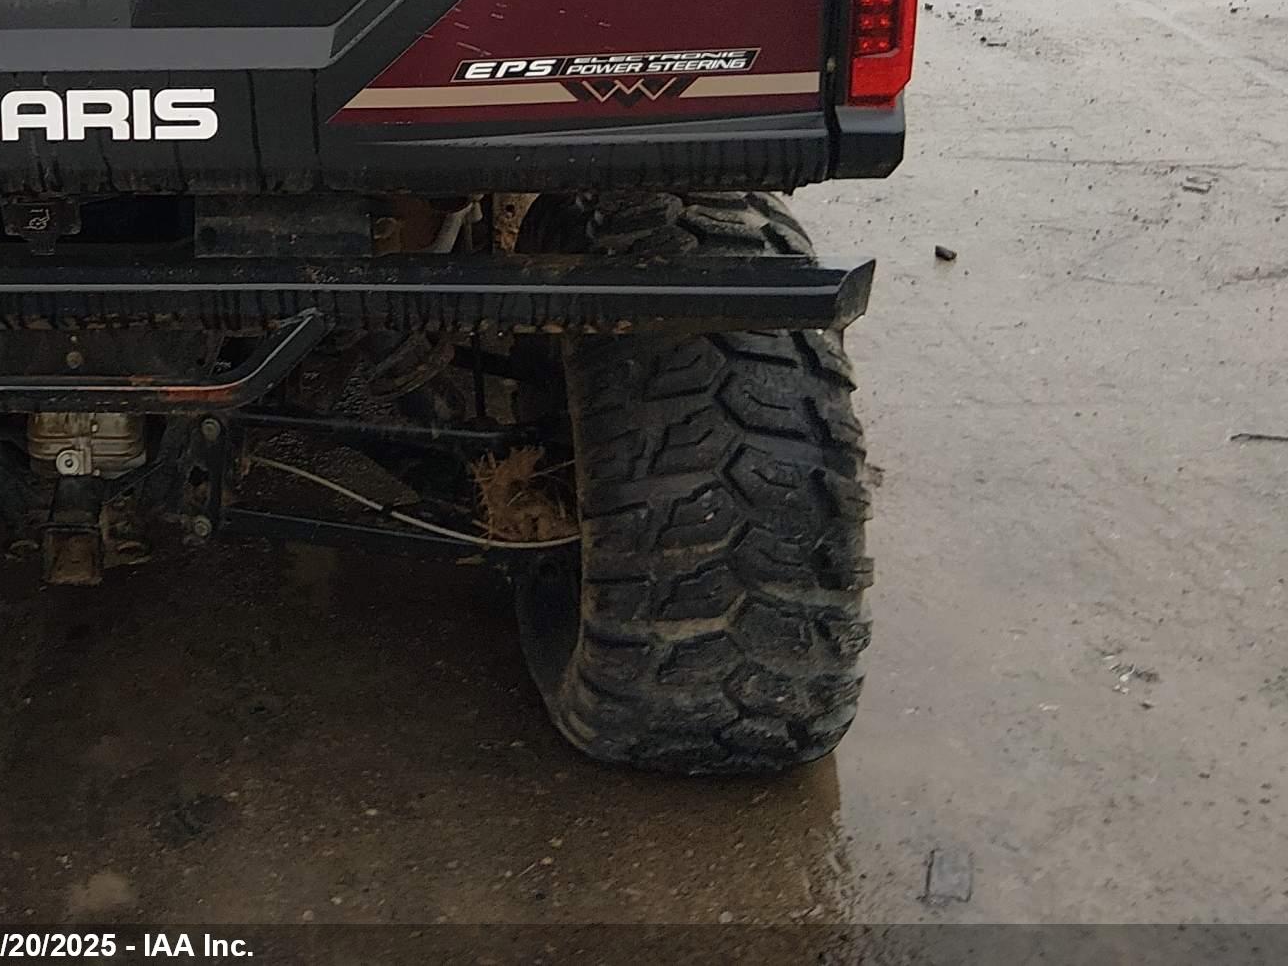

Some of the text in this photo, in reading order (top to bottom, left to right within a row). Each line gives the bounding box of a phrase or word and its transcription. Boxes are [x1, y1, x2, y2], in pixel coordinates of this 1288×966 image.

[464, 59, 557, 79] EPS
[566, 58, 746, 75] POWER STEERING
